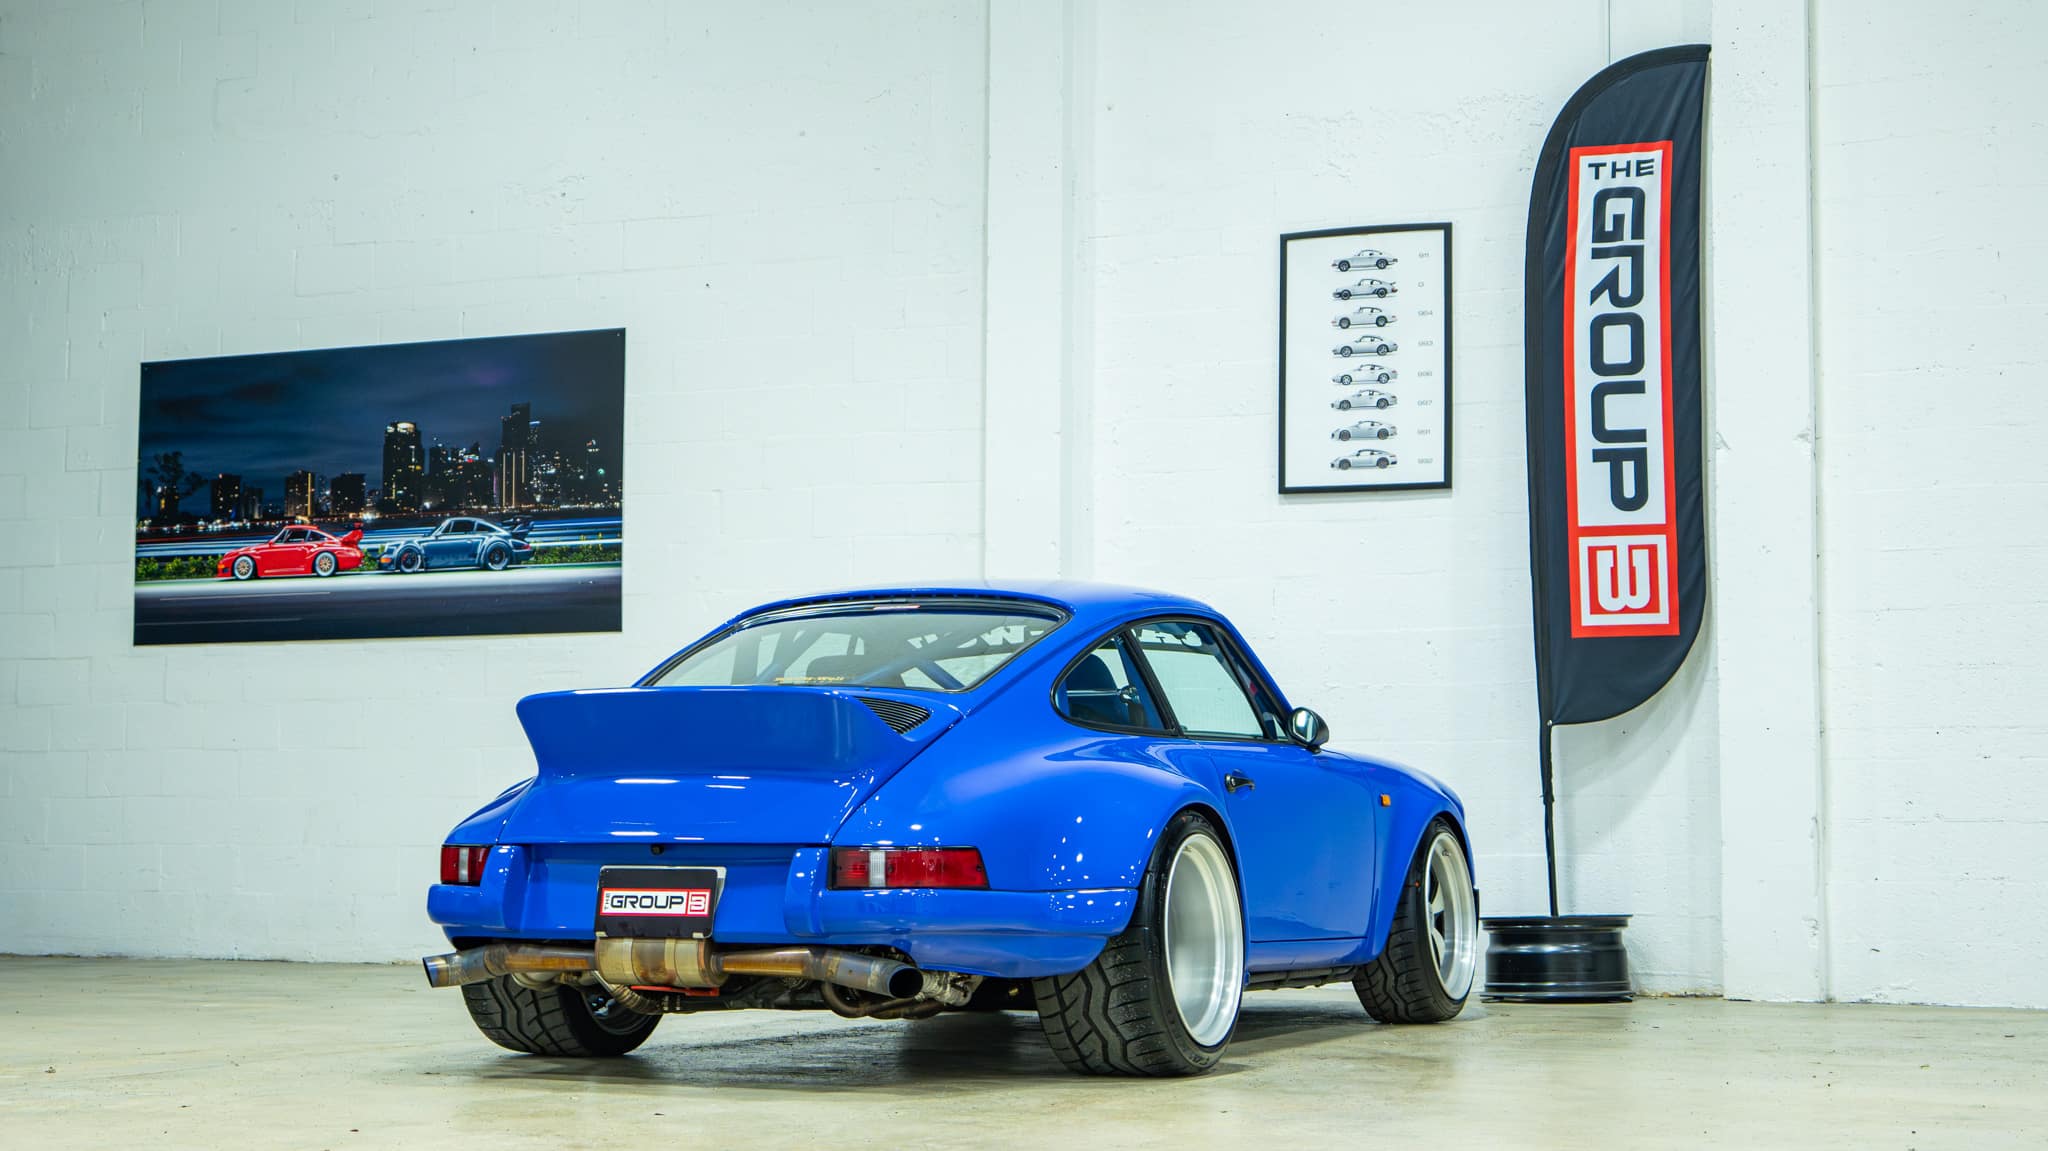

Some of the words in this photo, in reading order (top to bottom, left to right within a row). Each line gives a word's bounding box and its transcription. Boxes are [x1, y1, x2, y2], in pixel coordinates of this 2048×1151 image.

[1588, 158, 1655, 179] THE
[1589, 186, 1648, 512] GROUP
[610, 895, 684, 909] GROUP
